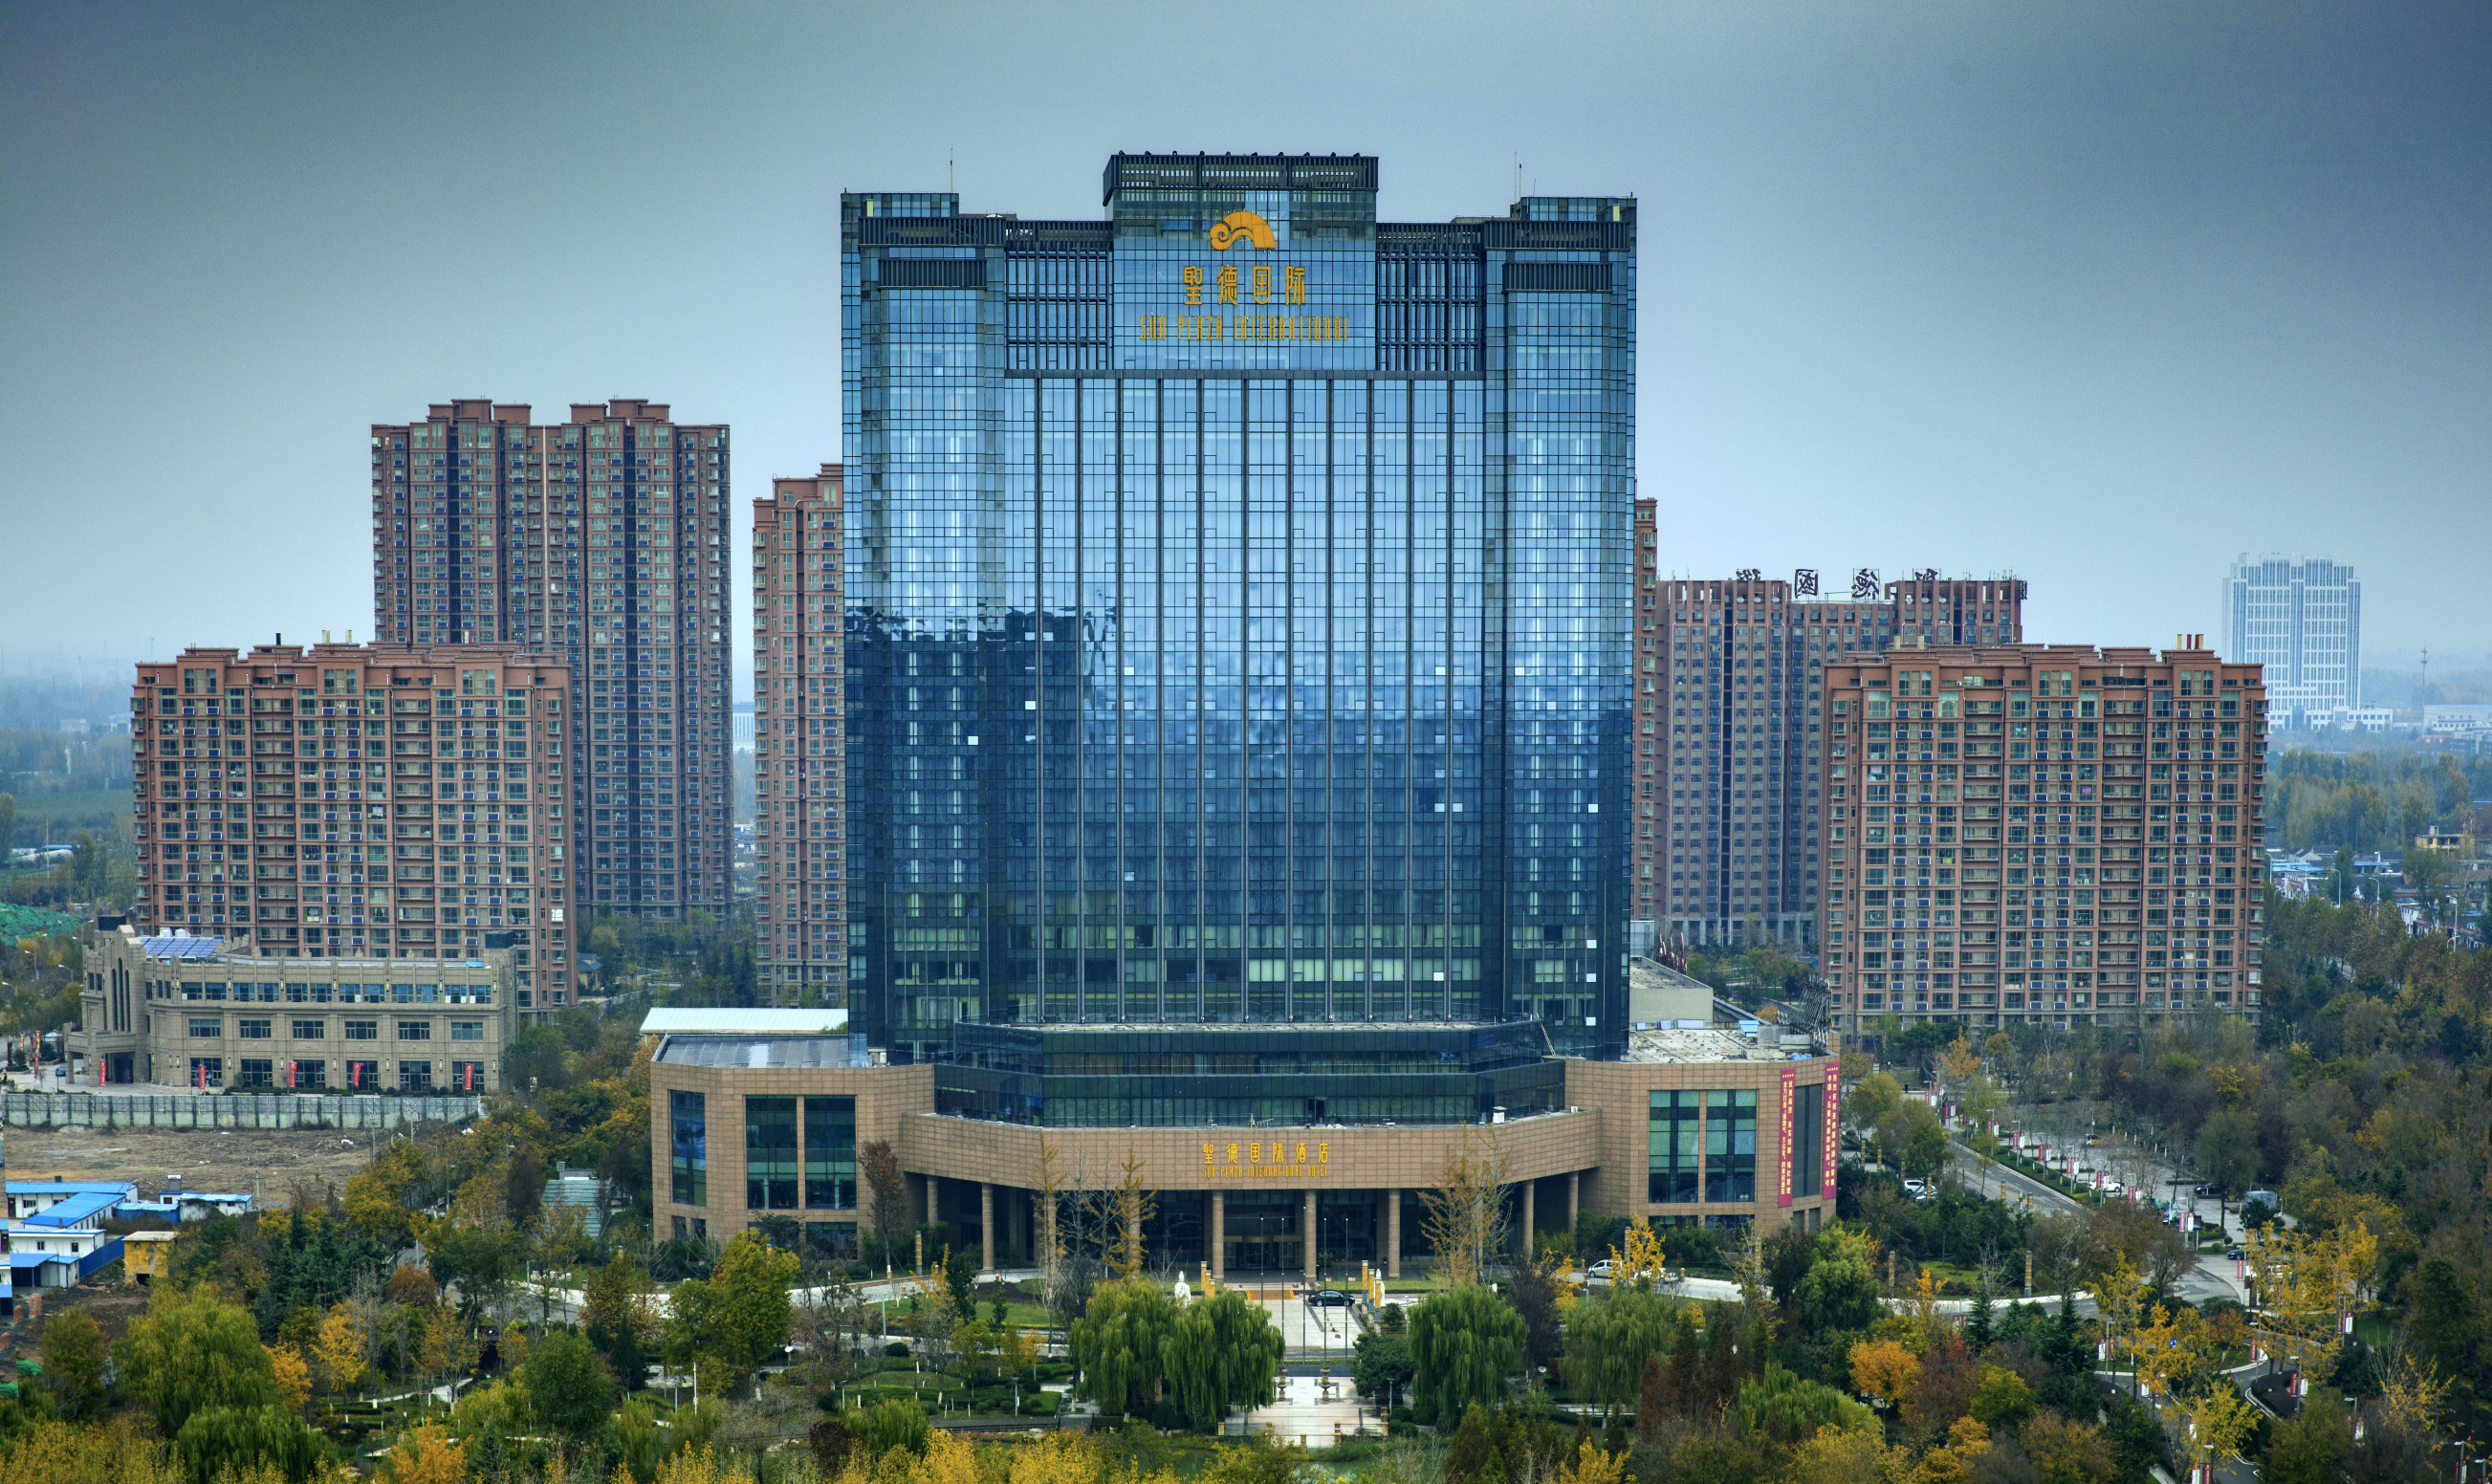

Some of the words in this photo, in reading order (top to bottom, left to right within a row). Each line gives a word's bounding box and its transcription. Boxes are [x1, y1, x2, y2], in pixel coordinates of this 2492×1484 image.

[1184, 265, 1305, 305] 聖德国际
[1140, 316, 1166, 340] SUN
[1178, 316, 1223, 340] PLAZA
[1234, 316, 1349, 341] INTERNATIONAL
[1203, 1142, 1328, 1164] 聖德国际酒店
[1203, 1166, 1215, 1178] SUN
[1220, 1166, 1243, 1178] PLAZA
[1247, 1166, 1302, 1177] INTERNATIONAL
[1306, 1166, 1328, 1177] HOTEL
